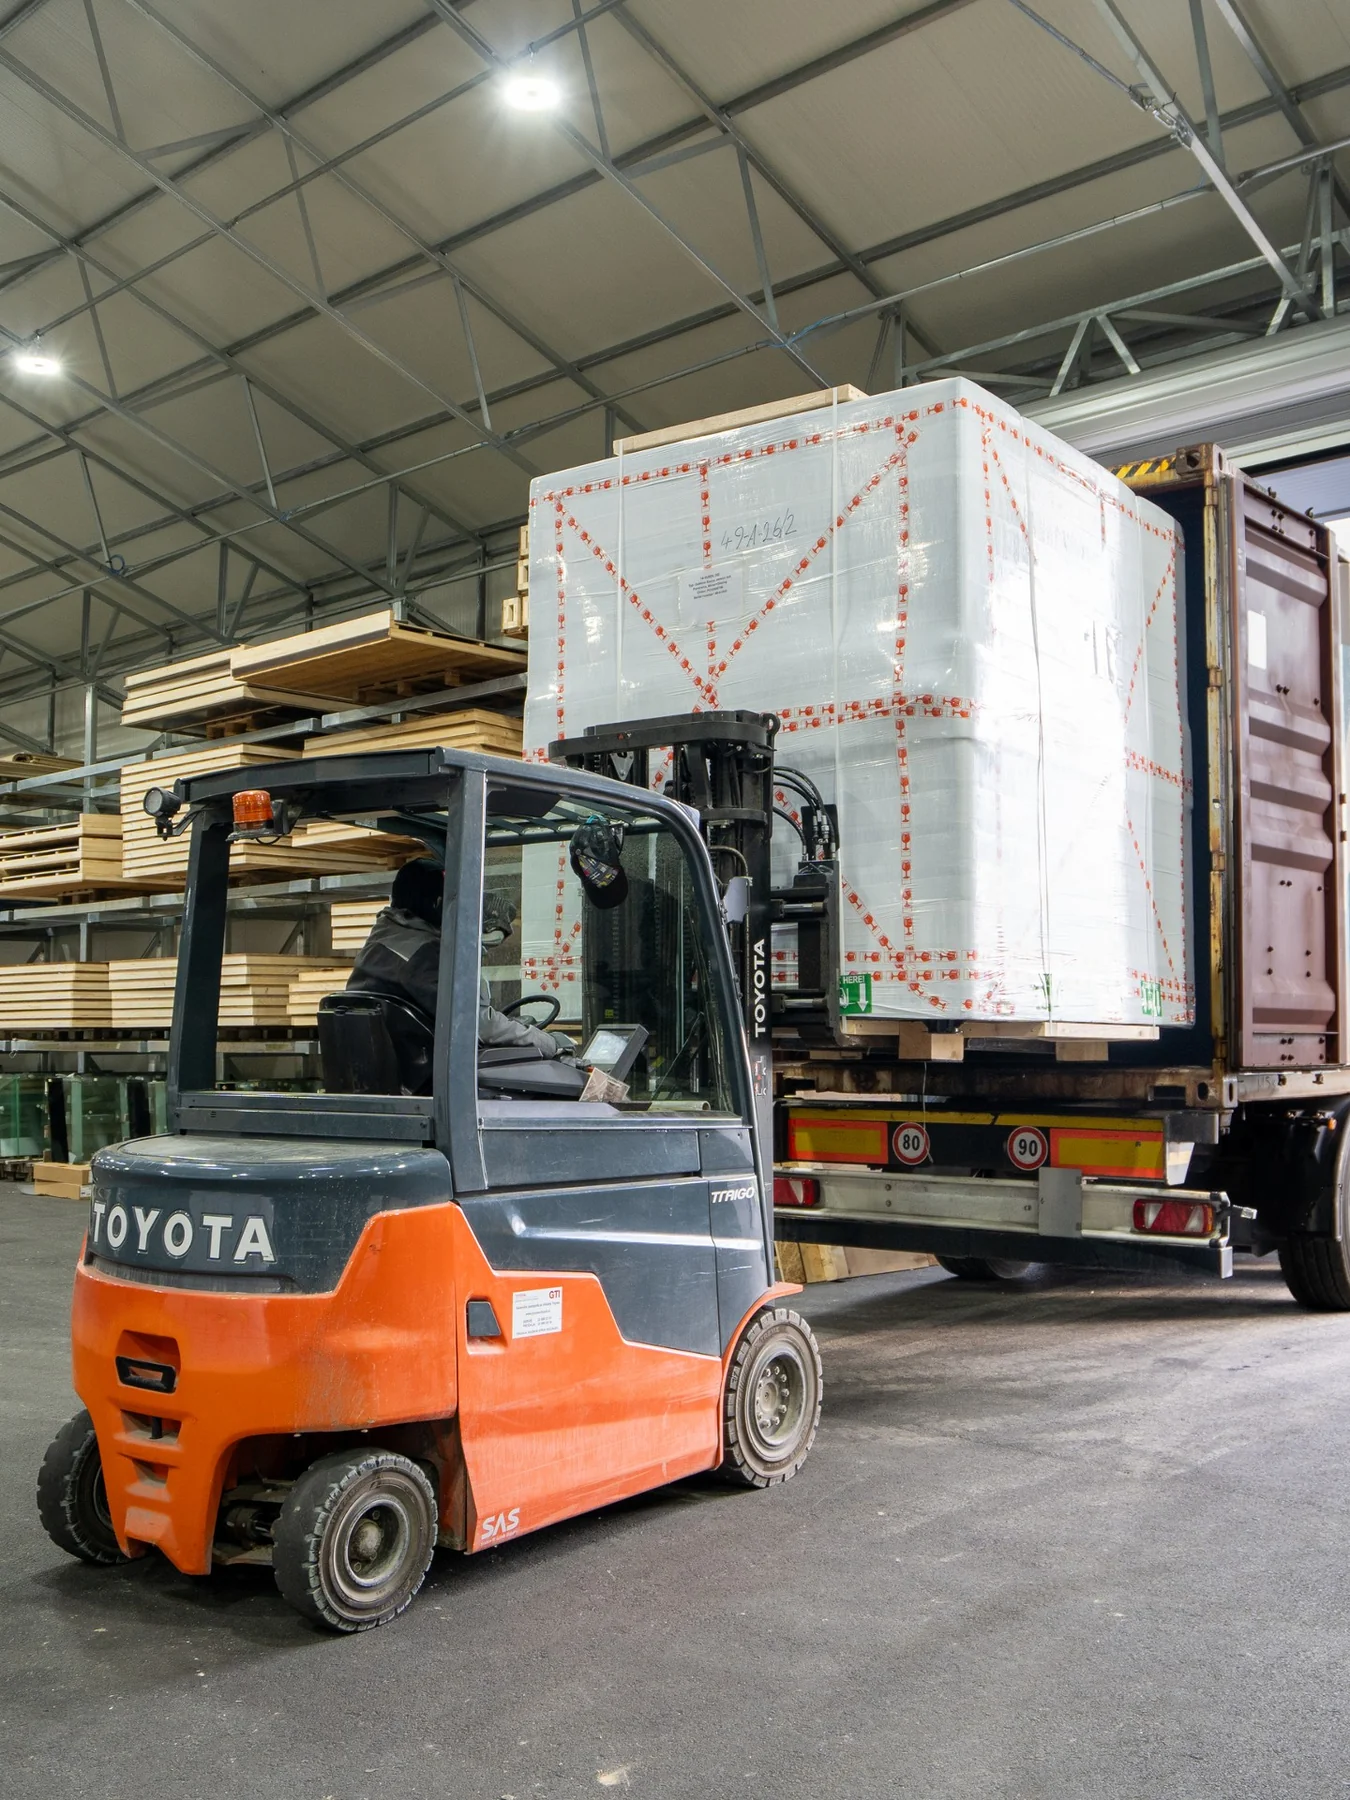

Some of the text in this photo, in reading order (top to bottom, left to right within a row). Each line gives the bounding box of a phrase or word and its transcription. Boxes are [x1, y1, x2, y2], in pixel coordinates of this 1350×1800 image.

[754, 939, 766, 1038] TOYOTA
[842, 975, 865, 985] HERE!
[903, 1134, 921, 1151] 80
[1018, 1139, 1038, 1157] 90
[93, 1203, 276, 1262] TOYOTA
[481, 1507, 520, 1540] SAS
